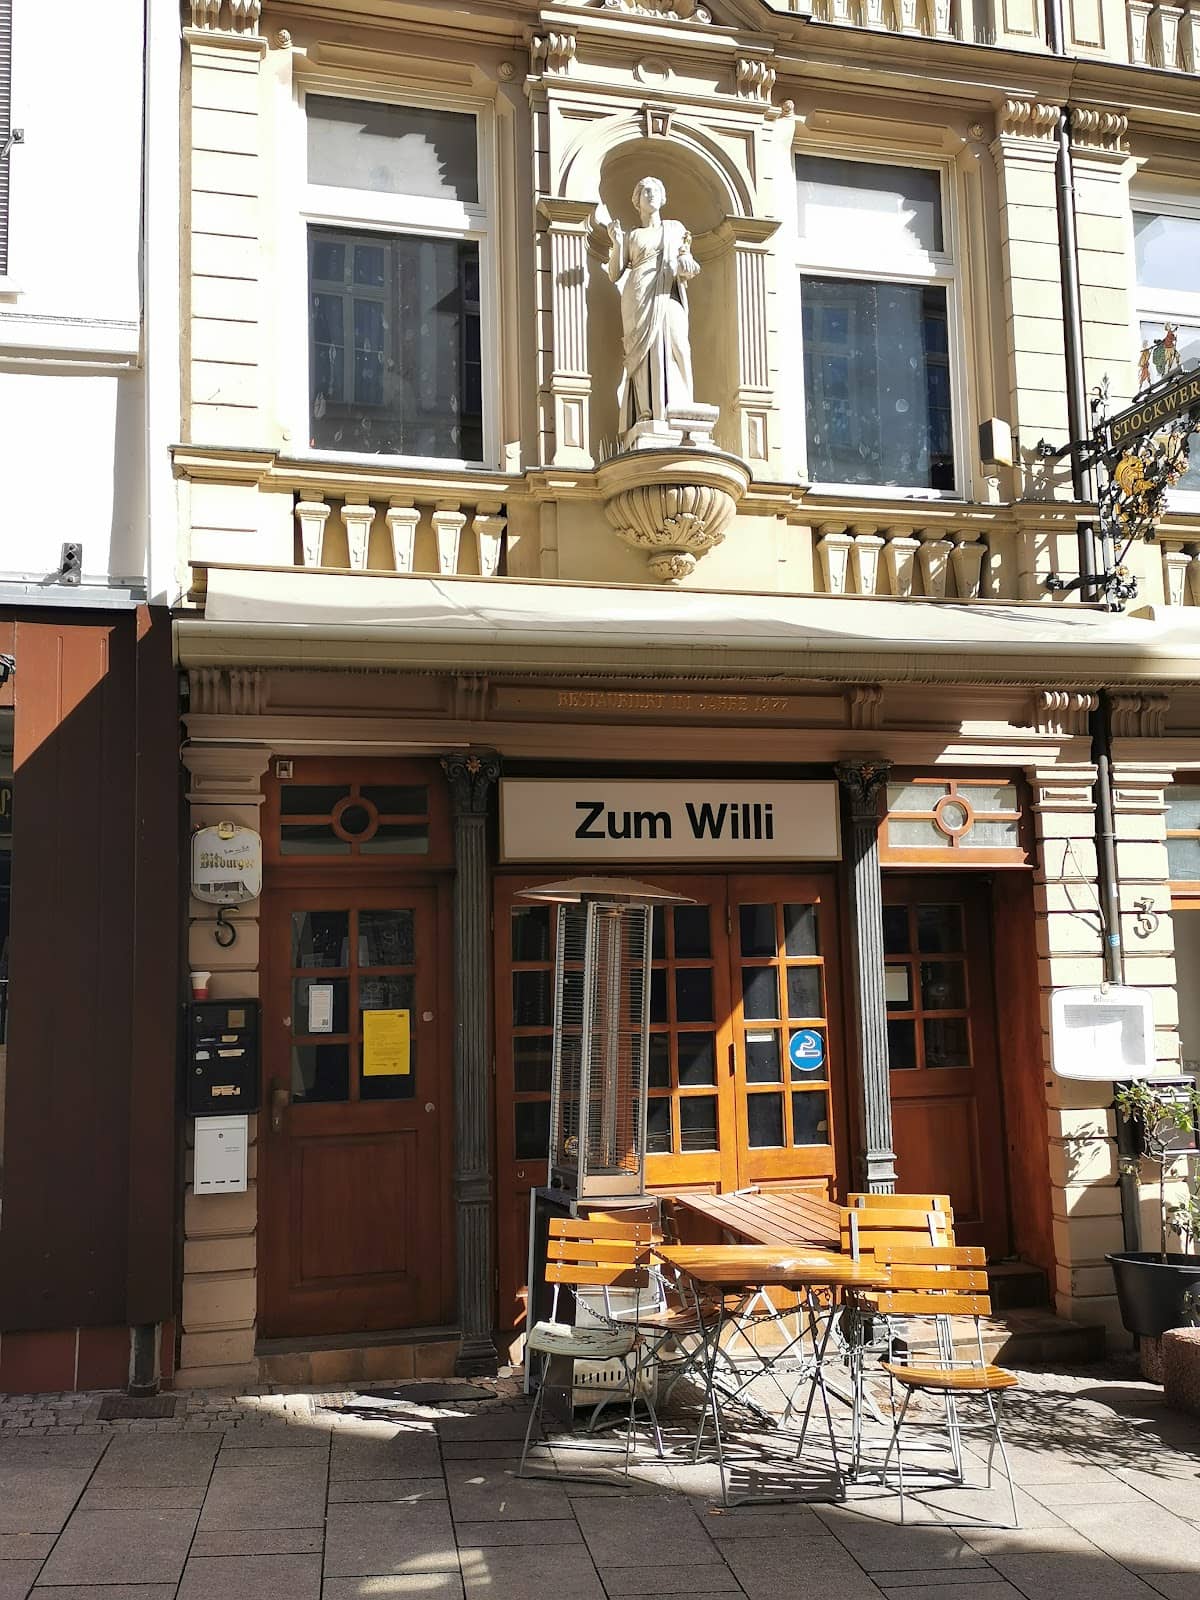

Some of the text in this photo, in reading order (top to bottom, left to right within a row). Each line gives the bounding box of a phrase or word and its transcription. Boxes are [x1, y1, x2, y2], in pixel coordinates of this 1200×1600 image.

[575, 802, 774, 839] Zum Willi
[214, 906, 240, 948] 5
